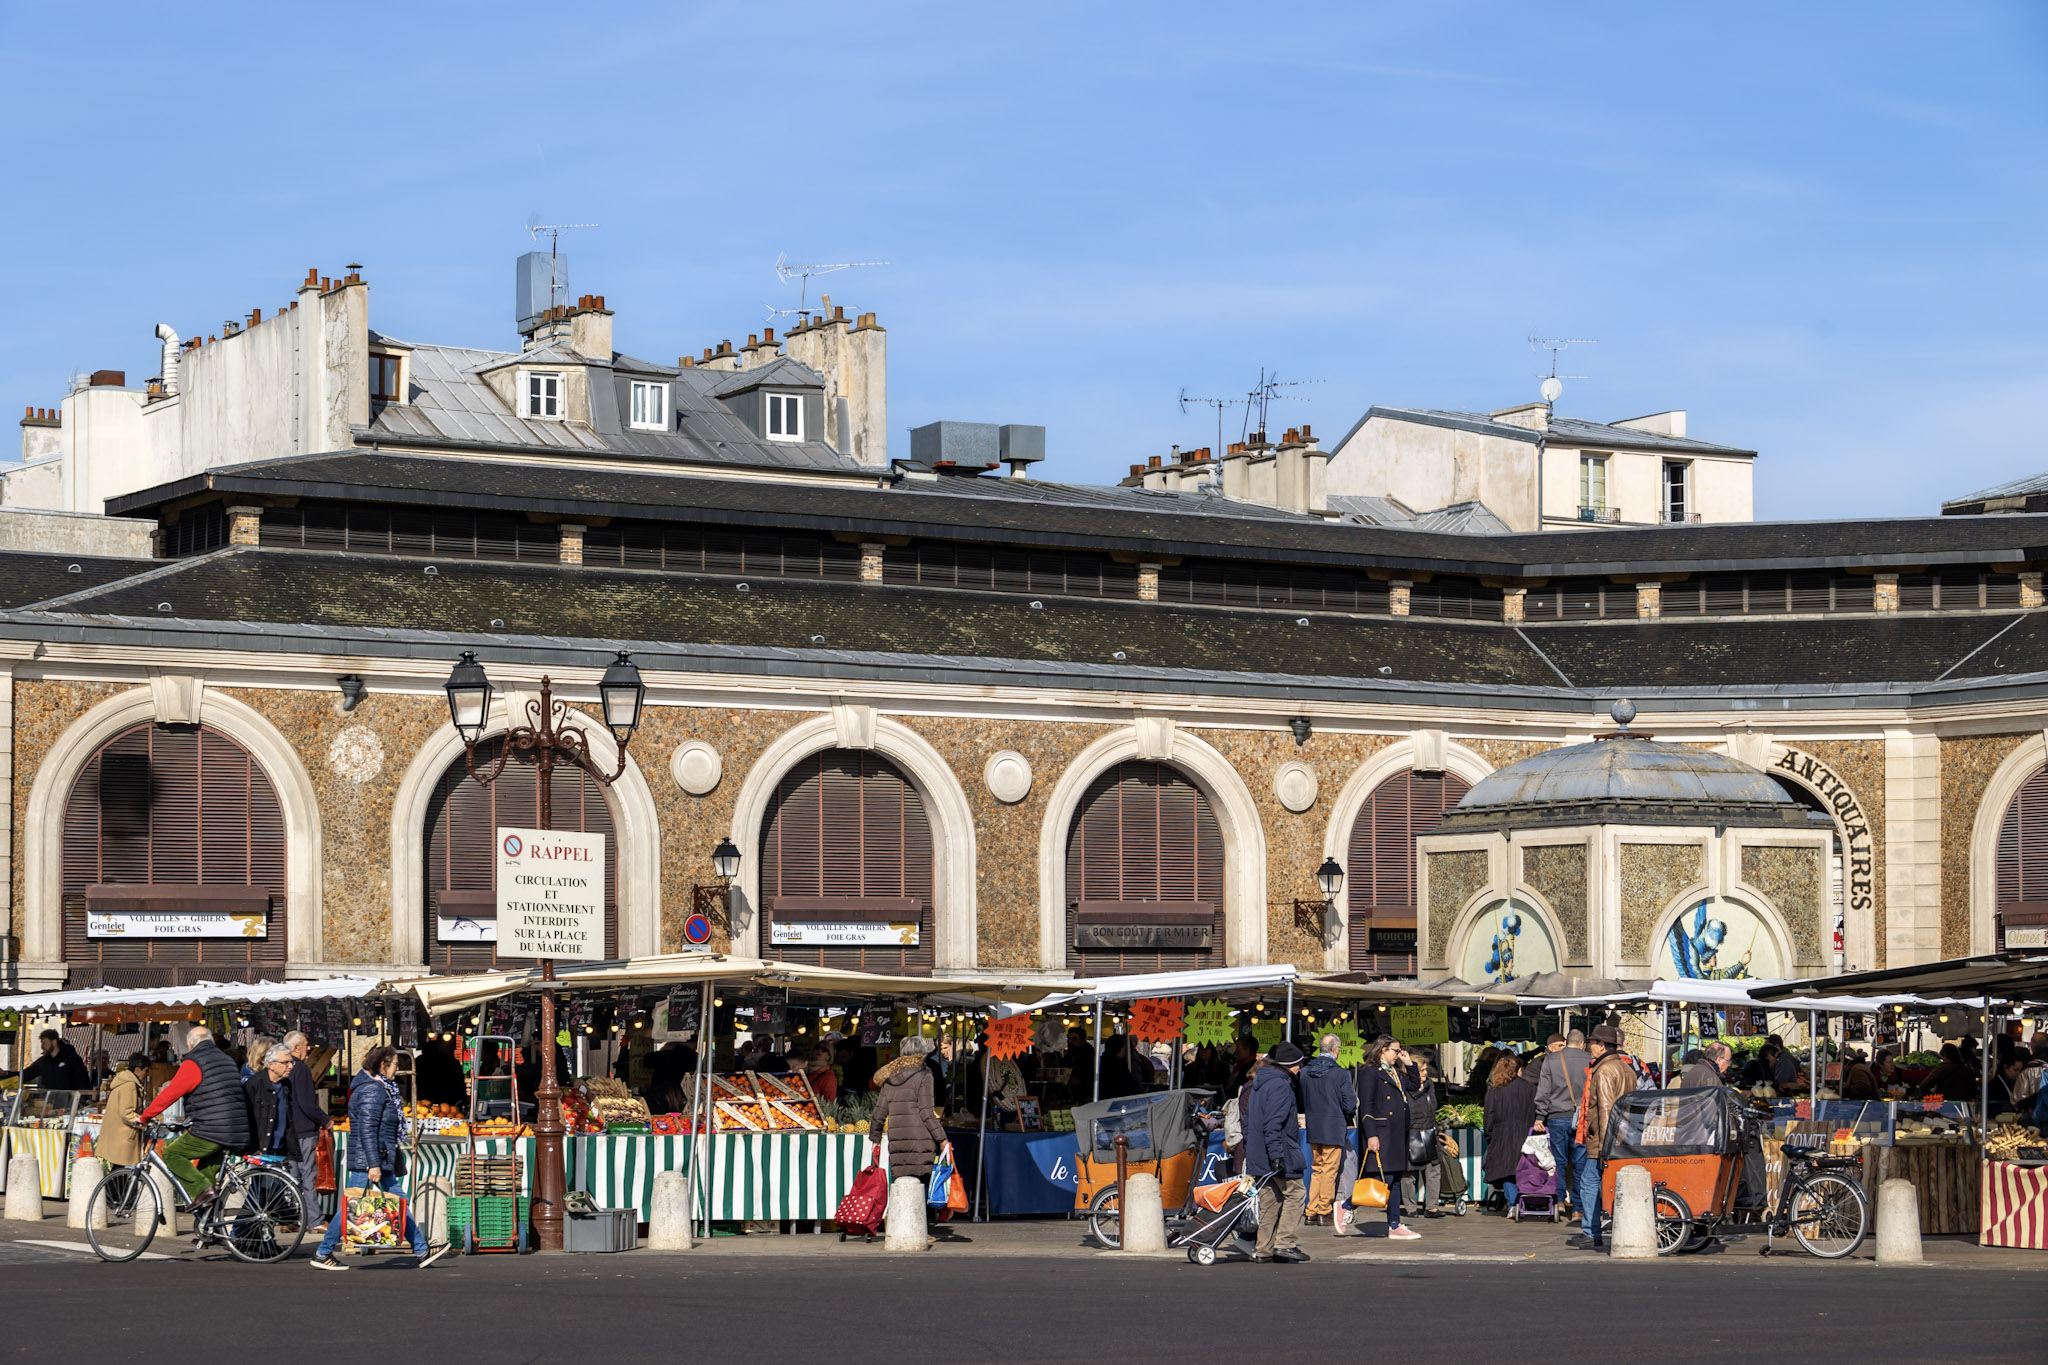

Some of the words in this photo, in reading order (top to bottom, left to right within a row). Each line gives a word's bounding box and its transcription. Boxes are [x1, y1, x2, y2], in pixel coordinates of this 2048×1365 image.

[1775, 749, 1873, 910] ANTIQUAIRES
[530, 845, 593, 861] RAPPEL
[515, 875, 588, 888] CIRCULATION
[545, 890, 558, 899] ET
[506, 901, 596, 915] STATIONNEMENT
[129, 914, 180, 922] VOLAILLES
[190, 914, 227, 922] GIBIERS
[523, 915, 579, 927] INTERDITS
[90, 921, 125, 930] Gentelet
[154, 925, 175, 933] FOIE
[178, 925, 202, 933] GRAS
[514, 929, 535, 939] SUR
[538, 929, 551, 939] LA
[554, 930, 588, 941] PLACE
[773, 930, 802, 938] Gentelet
[1092, 927, 1114, 937] BON
[1147, 927, 1209, 937] FERMIER
[2007, 929, 2041, 944] Olives
[520, 942, 534, 952] DU
[537, 942, 583, 954] MARCHE
[1393, 1007, 1438, 1021] ASPERGES
[1740, 1010, 1746, 1021] 2
[1844, 1017, 1862, 1031] 19,99
[1402, 1027, 1434, 1039] LANDES
[1050, 1157, 1069, 1181] le
